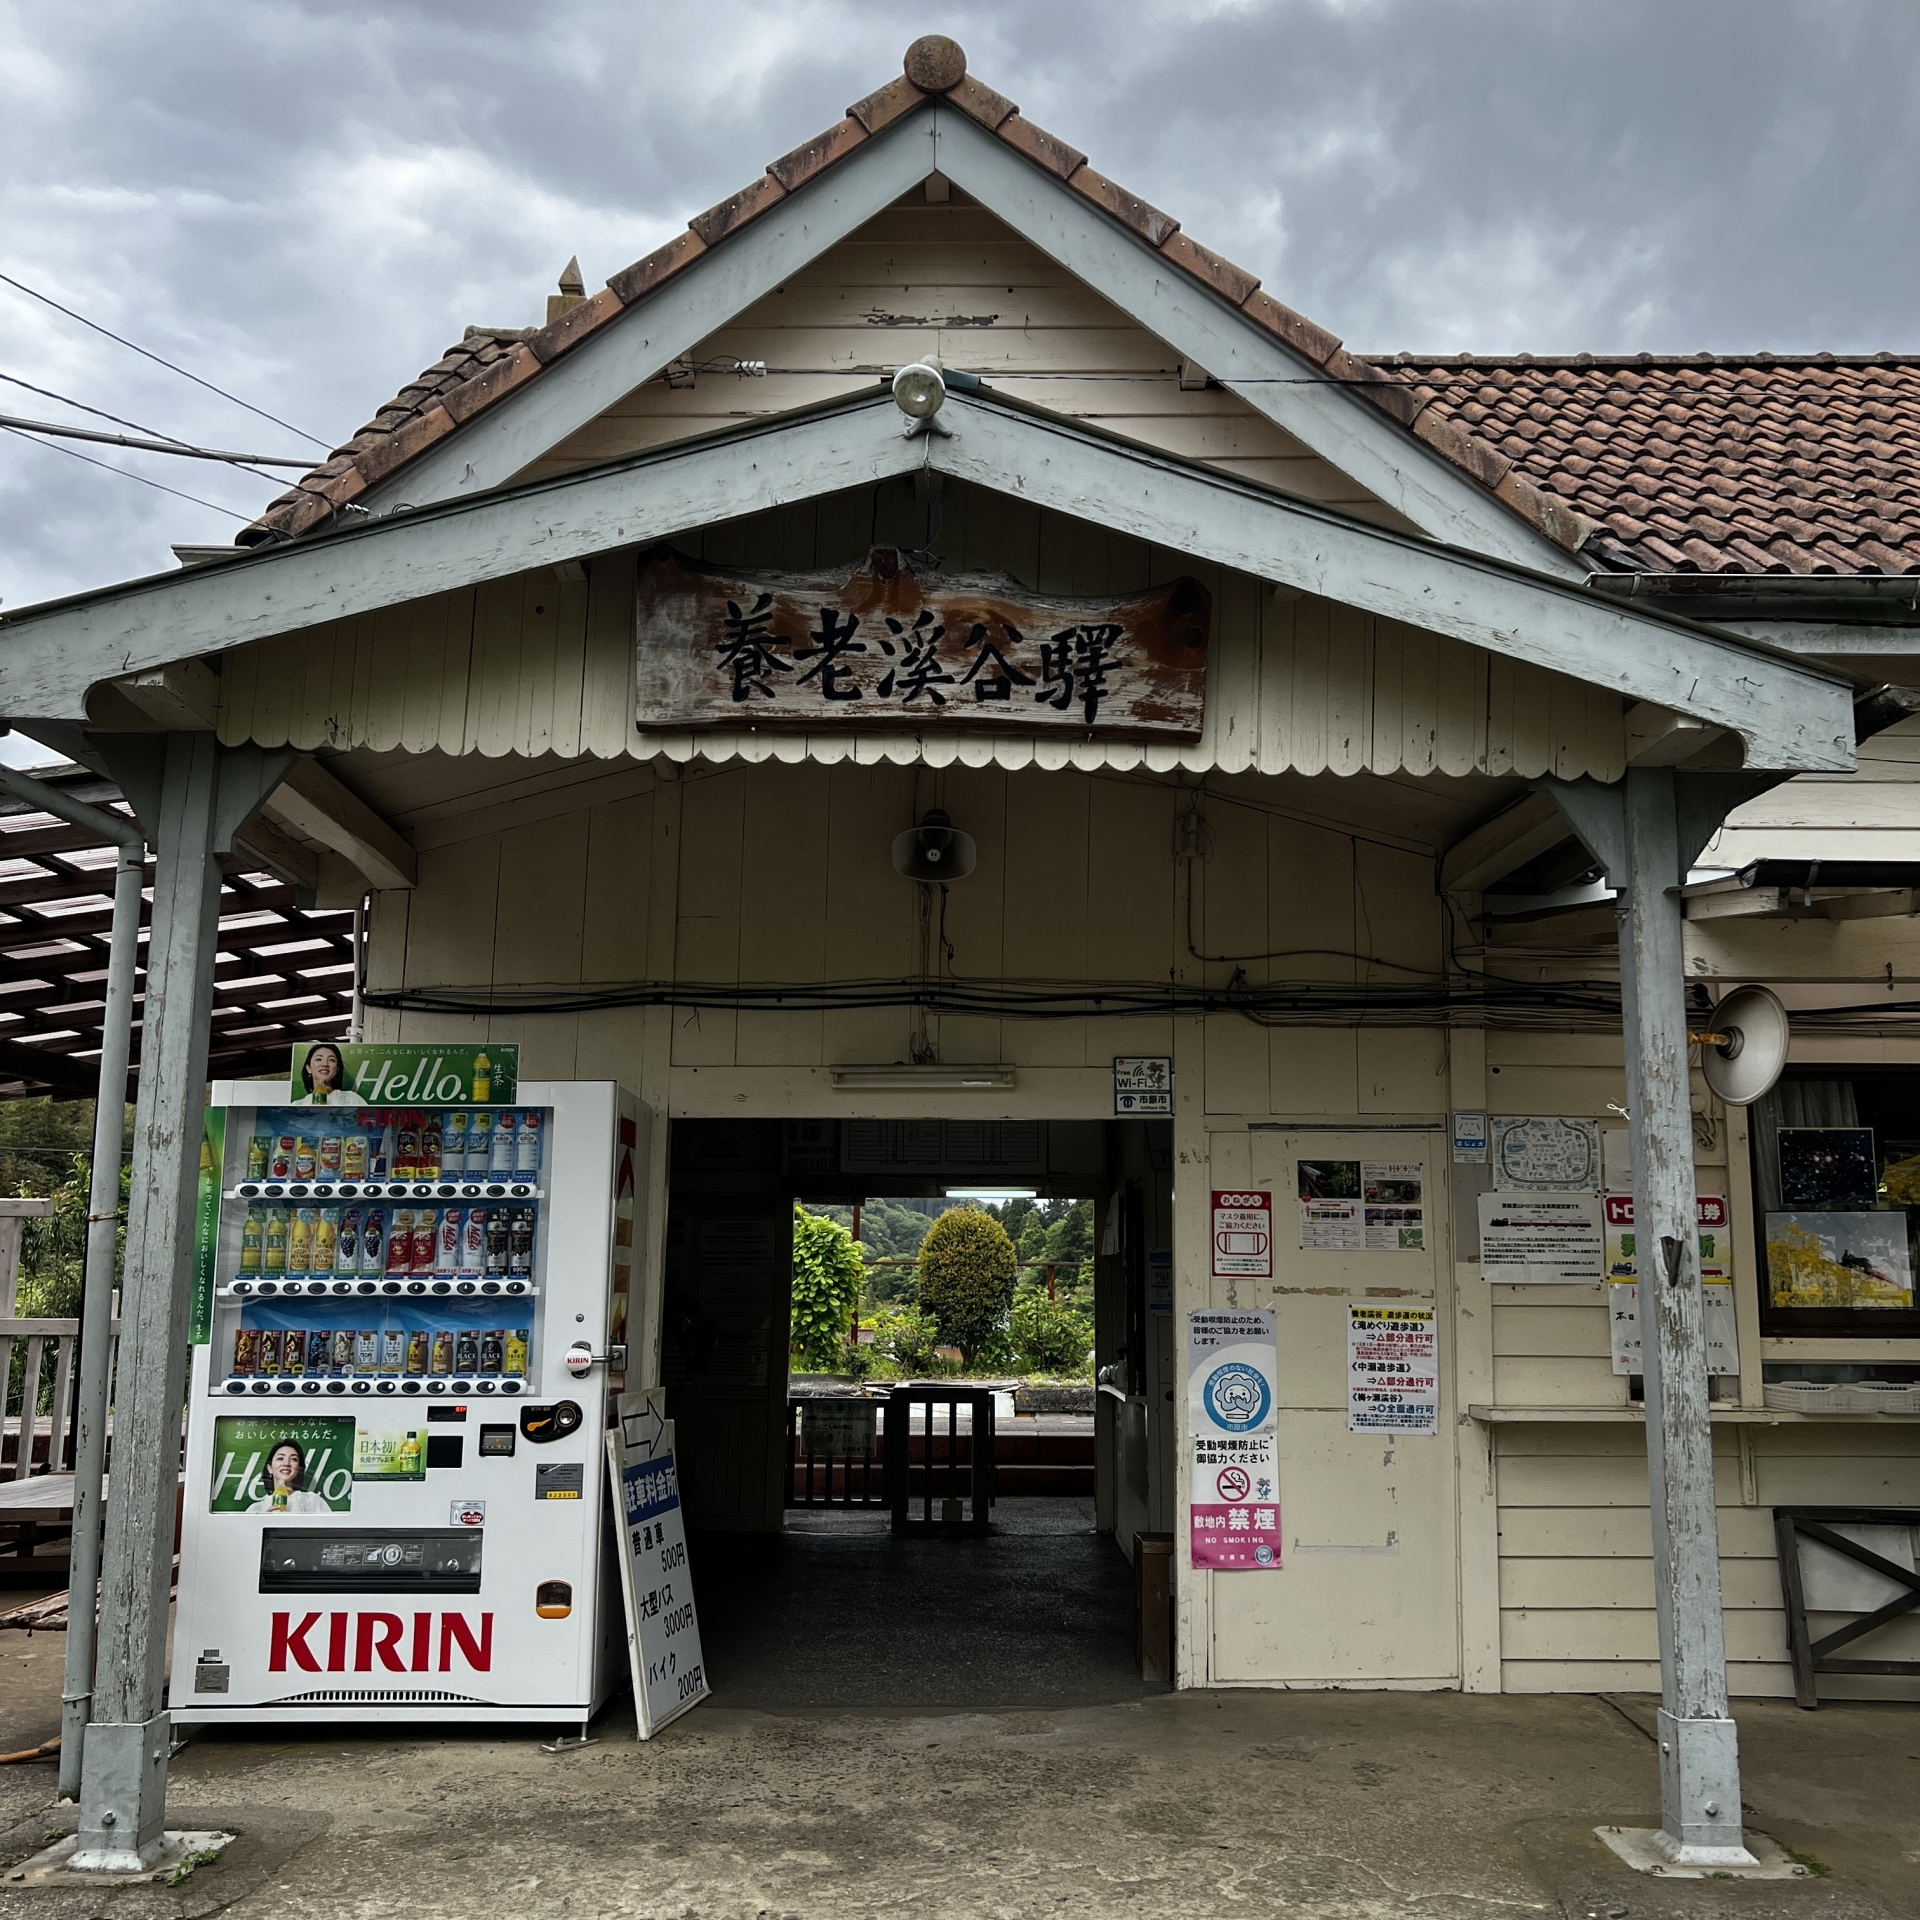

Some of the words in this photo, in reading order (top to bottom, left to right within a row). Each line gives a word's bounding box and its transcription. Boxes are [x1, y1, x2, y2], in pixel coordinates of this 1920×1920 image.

[714, 592, 1124, 723] 養老溪谷驛
[349, 1047, 470, 1056] お茶って、こんなにおいしくなれるんだ。
[353, 1057, 467, 1101] Hello.
[493, 1063, 505, 1086] 生茶
[1117, 1078, 1147, 1088] Wi-Fi
[1139, 1095, 1167, 1104] 市原市
[357, 1109, 426, 1127] KIRIN
[1222, 1196, 1261, 1205] おねがい
[1220, 1213, 1264, 1221] マスク着用に、
[1698, 1203, 1721, 1220] 券
[1219, 1221, 1265, 1229] ご協力ください
[1193, 1316, 1265, 1324] 受動喫煙防止のため、
[1386, 1311, 1433, 1320] 遊歩道の状況
[1193, 1327, 1269, 1335] 皆様のご協力をお願い
[1351, 1320, 1425, 1332] 《滝めぐり遊歩道》
[1193, 1337, 1220, 1345] します。
[1351, 1362, 1412, 1373] 《中瀬遊歩道》
[236, 1417, 328, 1427] お茶って、こんなに
[234, 1430, 338, 1440] おいしくなれるんだ。
[360, 1441, 397, 1454] 日本初!
[1195, 1440, 1269, 1450] 受動喫煙防止に
[1196, 1453, 1270, 1464] 御協力ください
[623, 1467, 678, 1513] 駐車料金所
[1193, 1515, 1226, 1529] 敷地内
[1228, 1508, 1276, 1531] 禁煙
[631, 1521, 665, 1557] 普通車
[661, 1541, 686, 1574] 500円
[640, 1583, 674, 1622] 大型バス
[663, 1602, 694, 1639] 3000円
[268, 1611, 494, 1673] KIRIN
[648, 1650, 677, 1687] バイク
[677, 1665, 702, 1701] 200円
